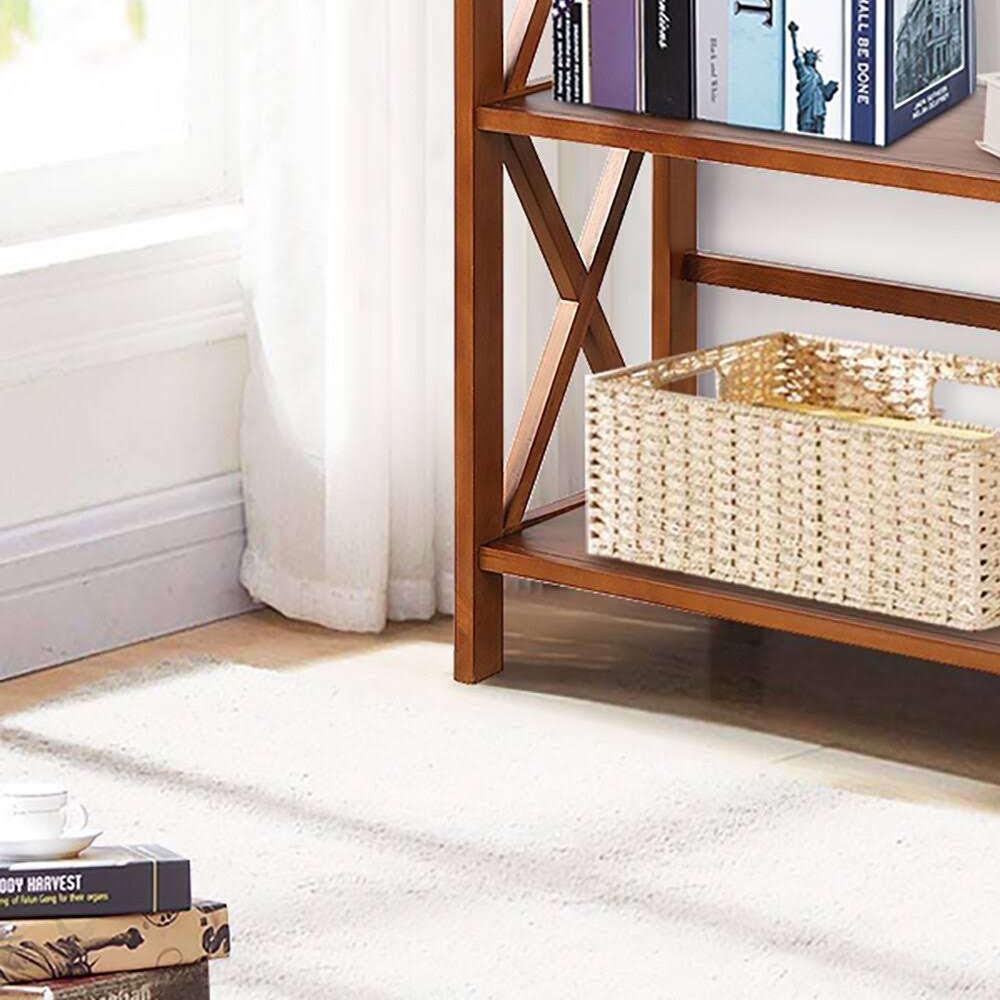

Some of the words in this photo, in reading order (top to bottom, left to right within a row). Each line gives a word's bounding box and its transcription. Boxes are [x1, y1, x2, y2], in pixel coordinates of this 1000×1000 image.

[857, 37, 870, 57] BE
[857, 62, 870, 105] DONE
[27, 874, 83, 892] HARVEST
